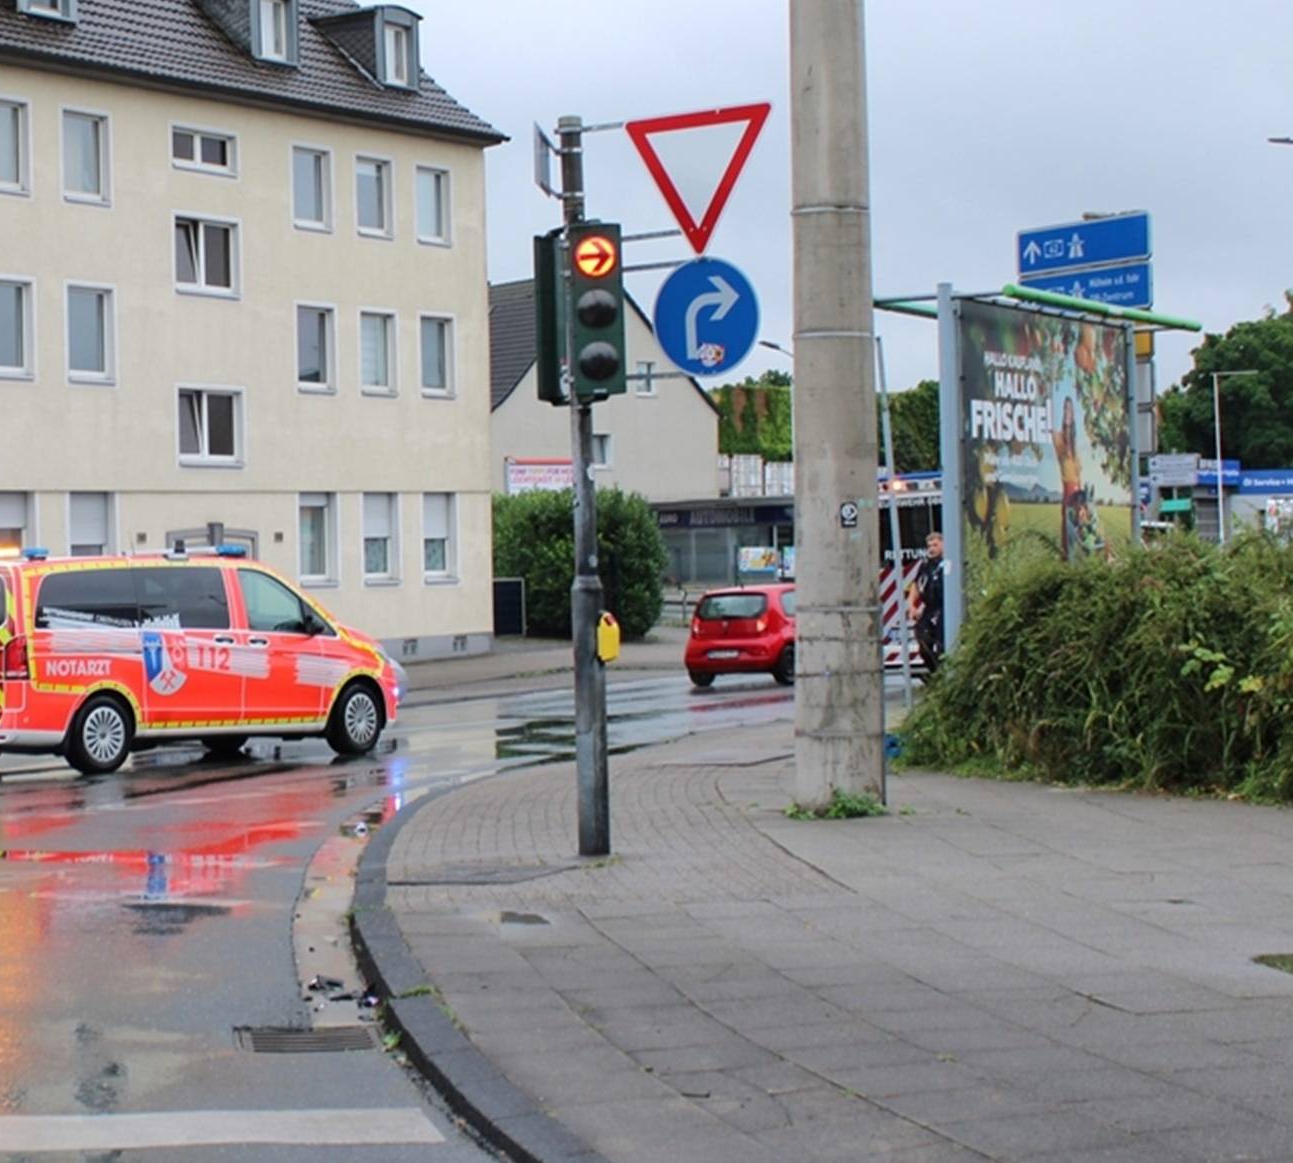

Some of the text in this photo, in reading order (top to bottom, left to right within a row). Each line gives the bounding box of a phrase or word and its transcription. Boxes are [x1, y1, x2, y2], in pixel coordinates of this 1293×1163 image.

[994, 370, 1037, 401] HALLO
[970, 398, 1053, 443] FRISCHE!
[1253, 478, 1281, 487] Service
[46, 659, 112, 677] NOTARZT
[197, 645, 231, 670] 112
